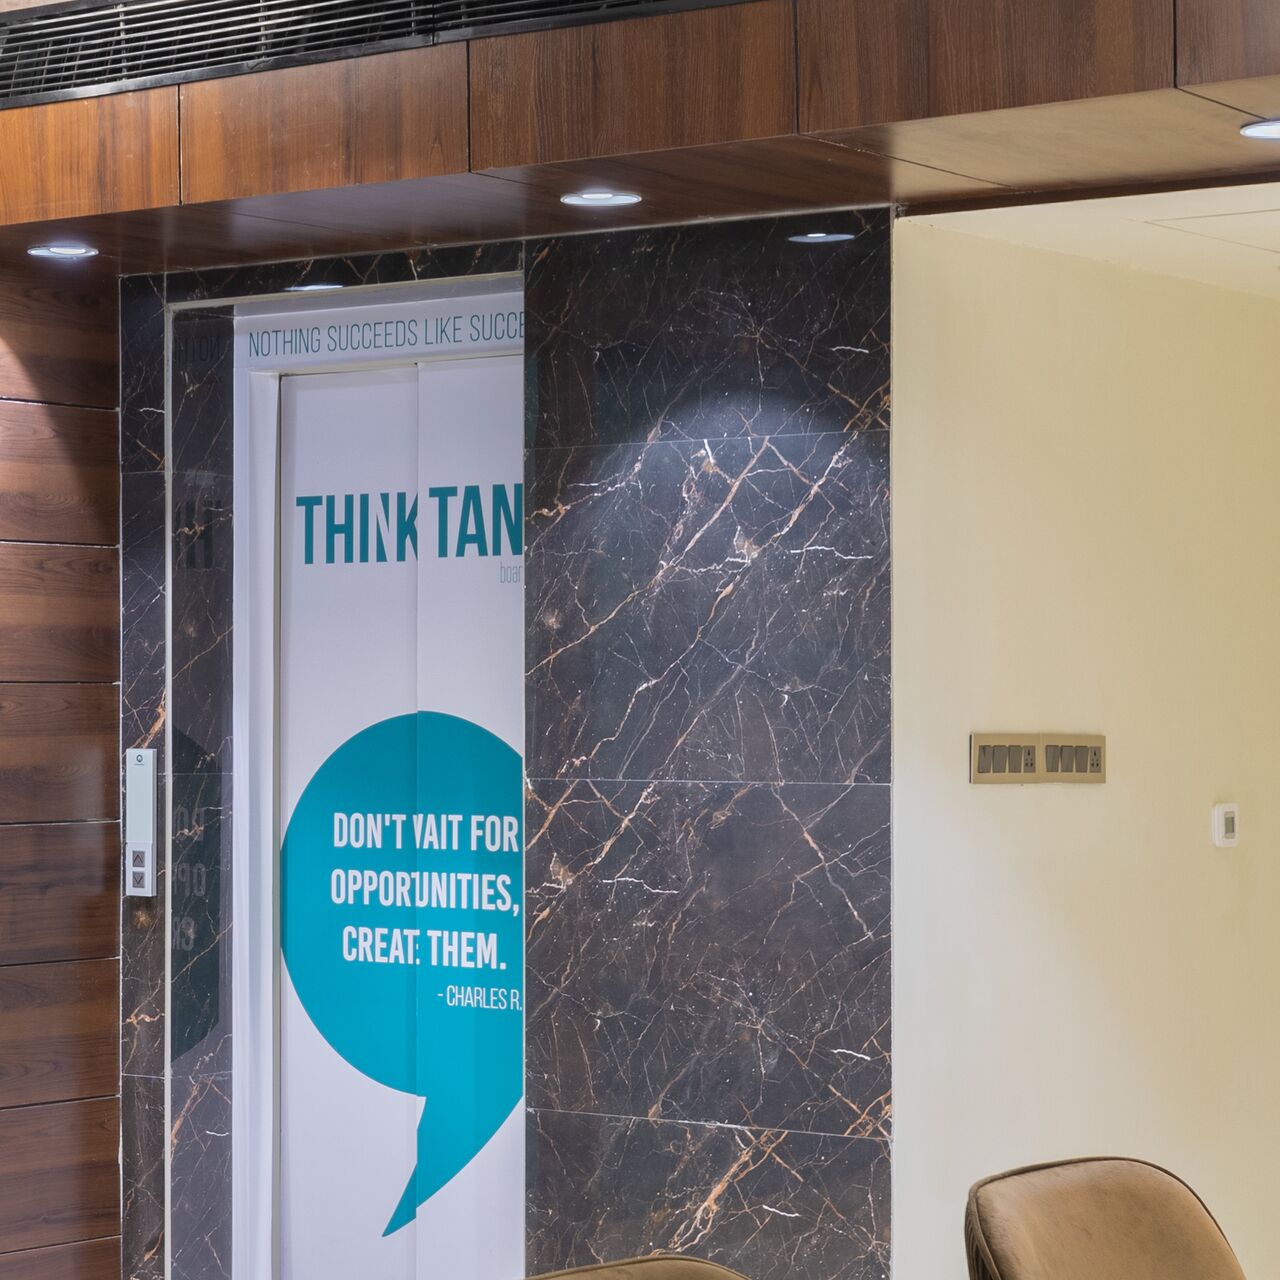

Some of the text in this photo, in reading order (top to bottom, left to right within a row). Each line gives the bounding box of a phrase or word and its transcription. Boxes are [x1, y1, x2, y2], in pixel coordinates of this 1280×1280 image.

[249, 326, 321, 358] NOTHING
[327, 319, 419, 352] SUCCEEDS
[424, 316, 463, 345] LIKE
[296, 491, 419, 565] THINK
[428, 483, 524, 558] TAN
[333, 812, 407, 850] DON'T
[471, 815, 519, 853] FOR
[426, 929, 507, 970] THEM.
[446, 984, 508, 1011] CHARLES
